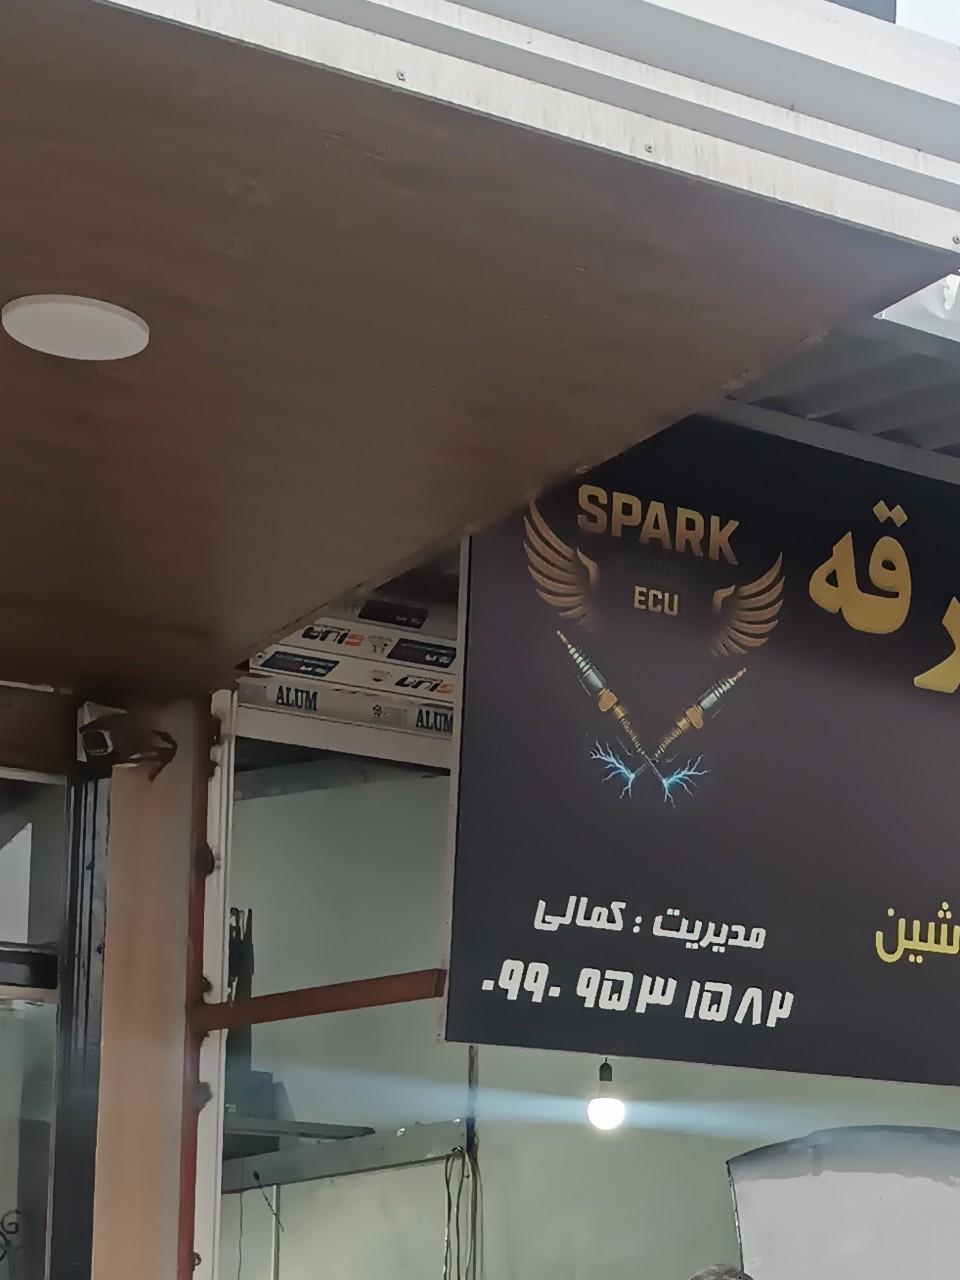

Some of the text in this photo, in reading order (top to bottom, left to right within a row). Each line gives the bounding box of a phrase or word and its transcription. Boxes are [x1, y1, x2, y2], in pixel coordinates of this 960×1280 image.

[576, 484, 740, 566] SPARK
[633, 585, 680, 617] ECU
[533, 895, 627, 932] کمالی
[576, 967, 678, 1014] ۹۵۳
[684, 980, 795, 1028] ۱۵۸۲
